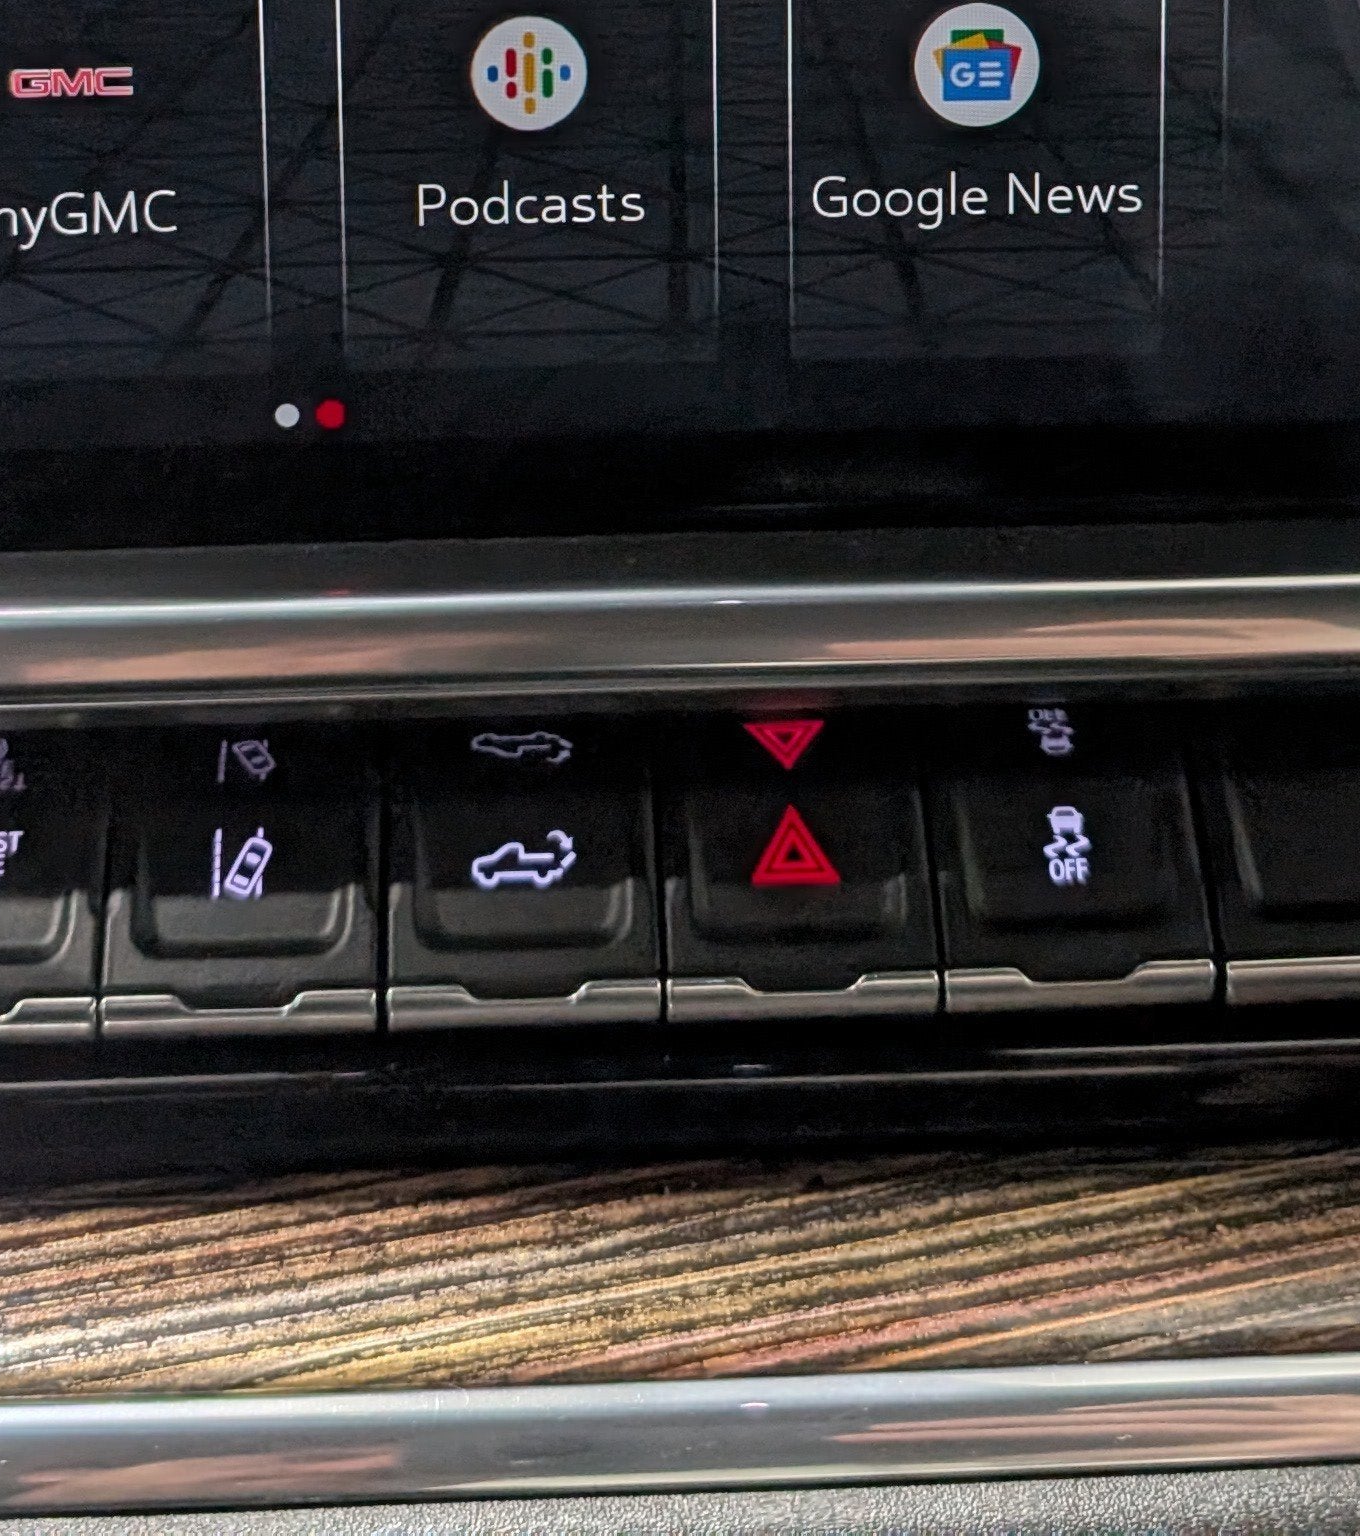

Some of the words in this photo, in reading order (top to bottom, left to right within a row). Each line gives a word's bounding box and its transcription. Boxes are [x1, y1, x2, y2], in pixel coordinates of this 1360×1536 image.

[8, 66, 134, 99] GMC
[418, 179, 645, 227] Podcasts
[812, 170, 988, 230] Google
[1008, 171, 1143, 215] News
[1048, 858, 1089, 882] OFF
